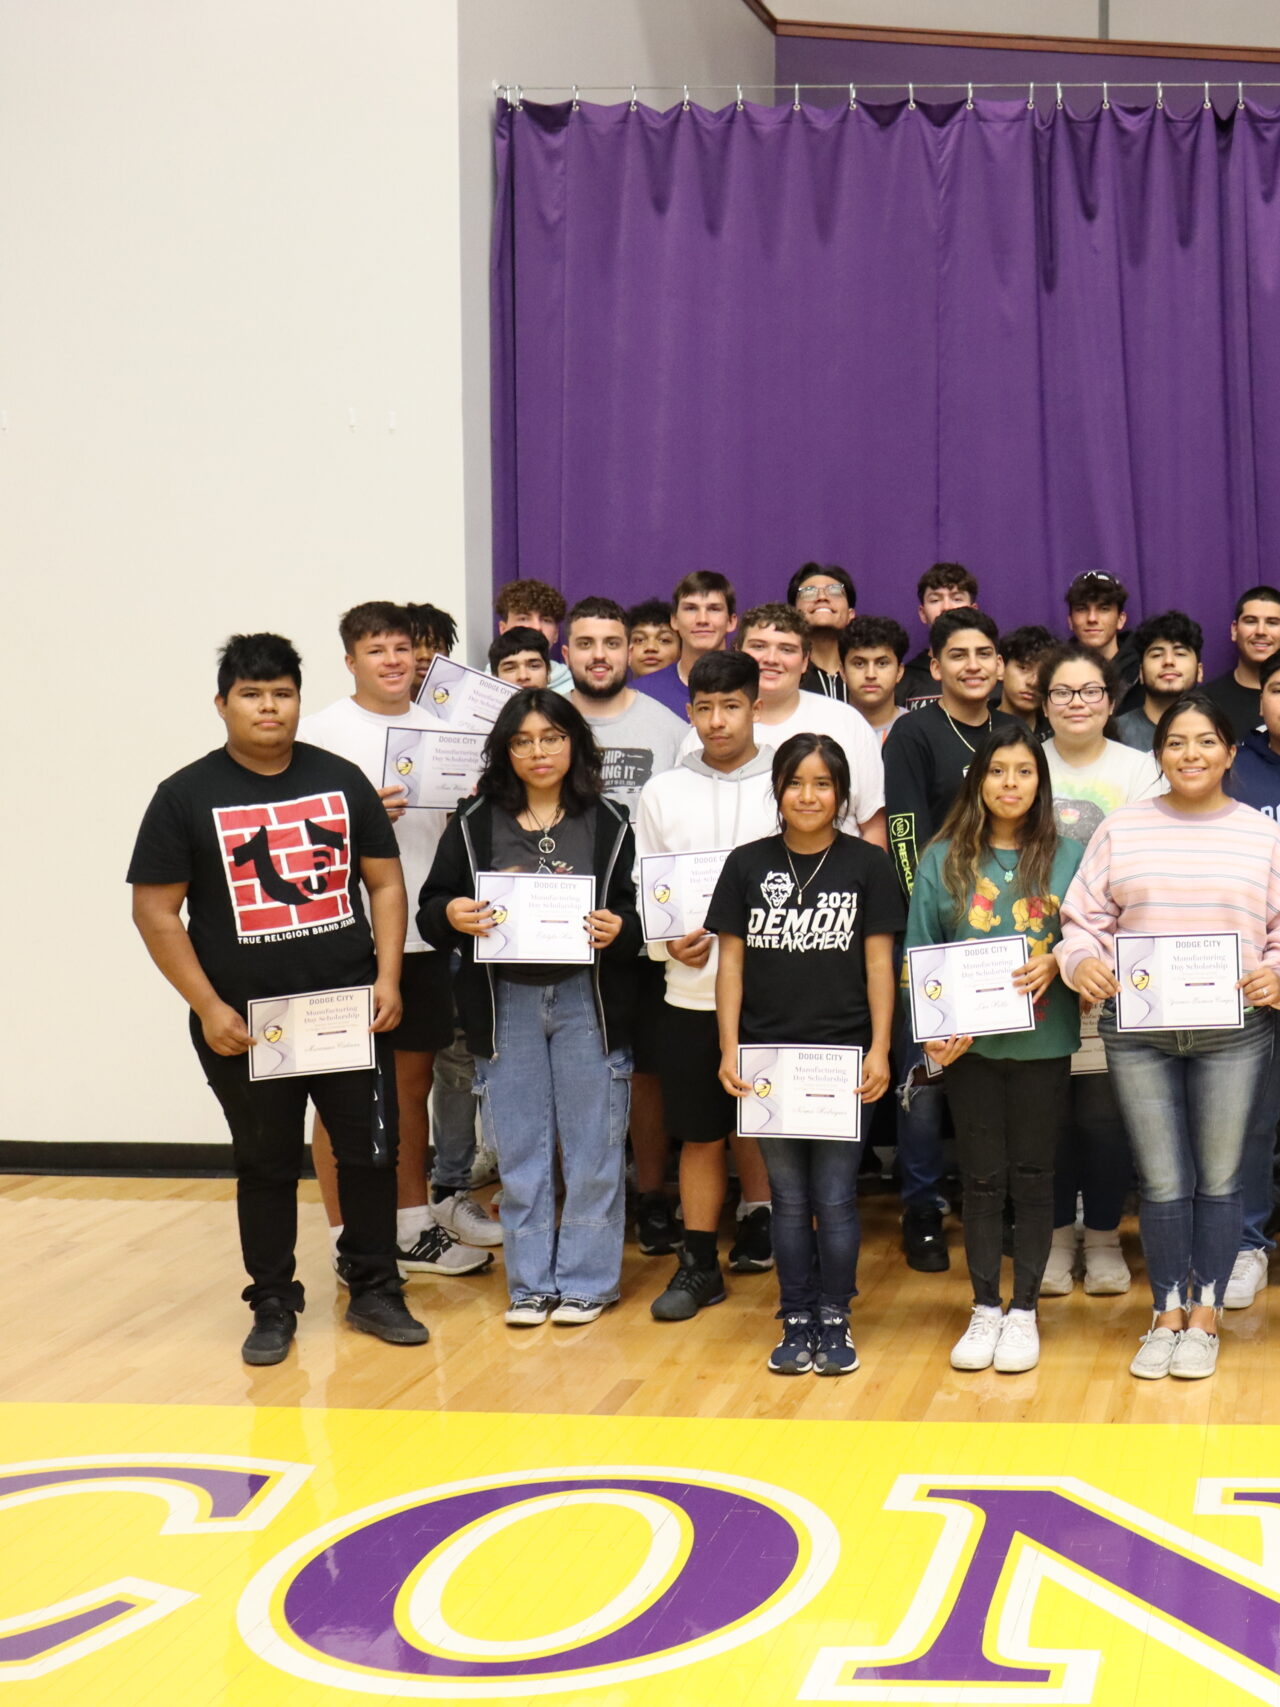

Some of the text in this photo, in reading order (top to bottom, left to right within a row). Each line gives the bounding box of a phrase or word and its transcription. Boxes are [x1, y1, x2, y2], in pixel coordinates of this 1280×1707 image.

[603, 750, 625, 764] HIP:
[601, 765, 636, 780] ING IT
[816, 892, 858, 908] 2021
[747, 907, 857, 935] DEMON
[237, 916, 356, 945] TRUE RELIGION BRAND JEANS
[747, 931, 855, 953] STATE ARCHERY
[1175, 939, 1221, 949] DODGE CITY
[964, 945, 1008, 957] DODGE CITY
[309, 994, 354, 1005] DODGE CITY
[798, 1052, 844, 1061] DODGE CITY
